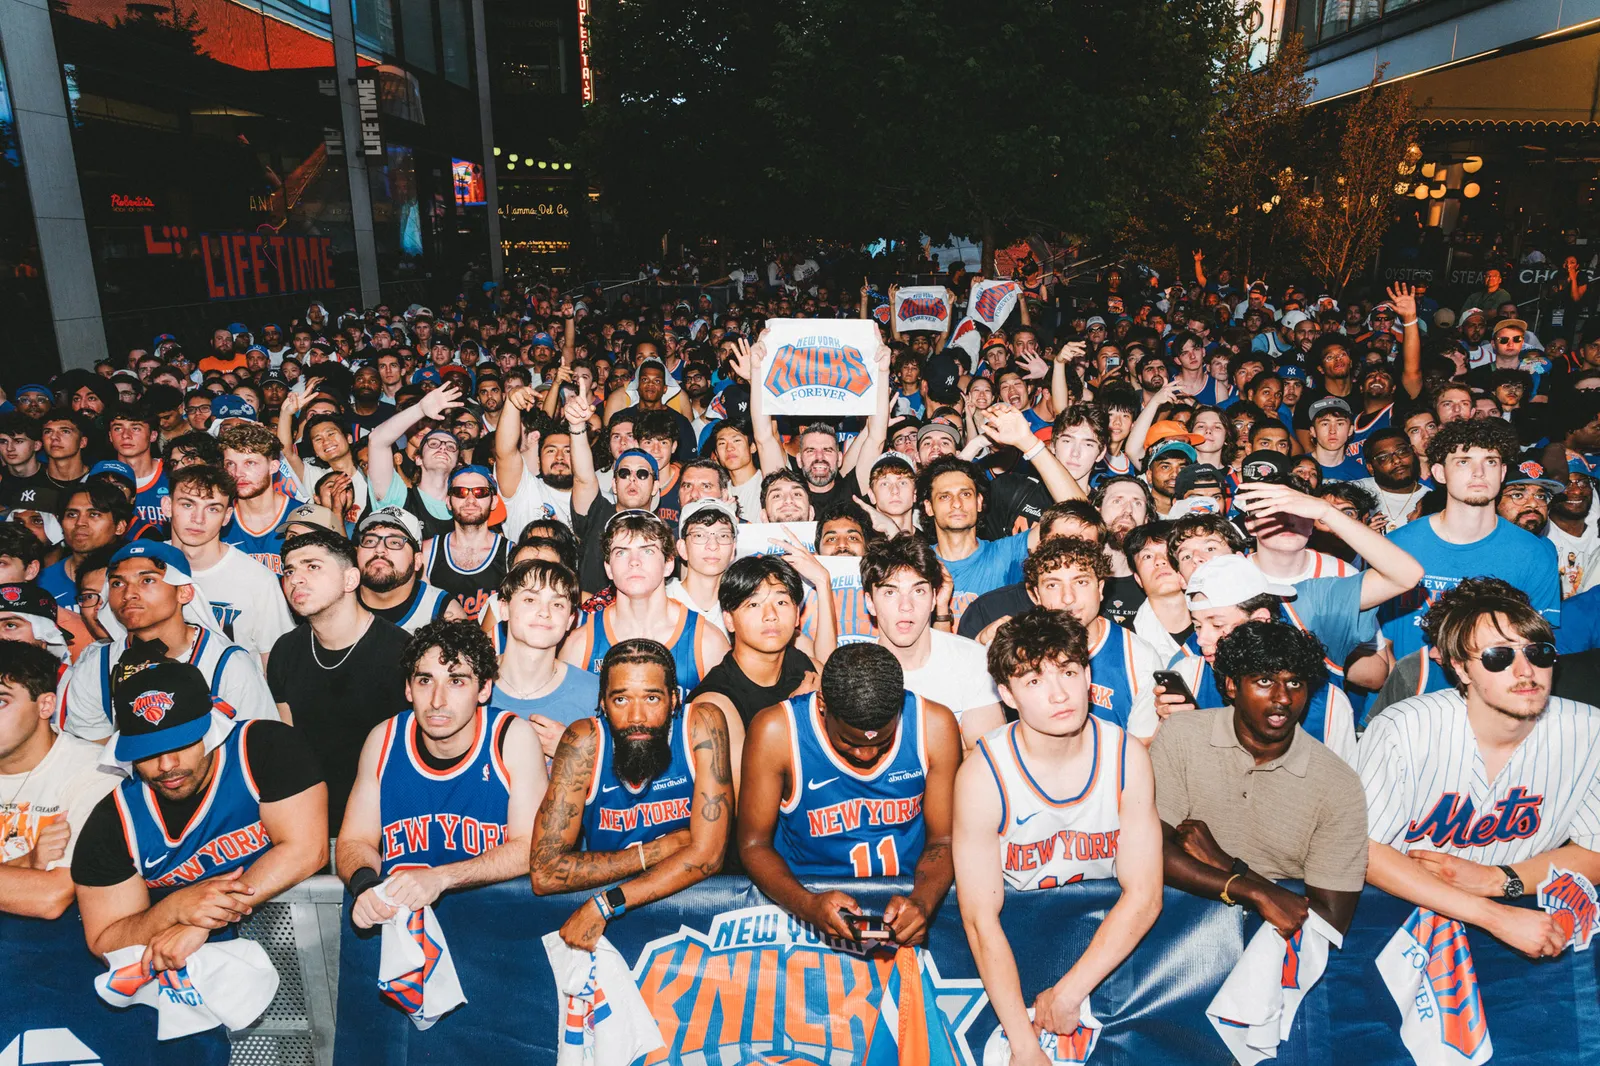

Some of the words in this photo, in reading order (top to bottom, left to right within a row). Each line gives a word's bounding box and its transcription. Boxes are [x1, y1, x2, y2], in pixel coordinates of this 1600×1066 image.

[111, 193, 155, 207] Roberta's
[201, 235, 269, 298] LIFE
[270, 236, 336, 293] TIME
[1452, 269, 1485, 284] STEA
[797, 336, 820, 349] NEW
[820, 336, 841, 348] YORK
[764, 344, 873, 398] KNICKS
[791, 386, 846, 401] FOREVER
[137, 505, 171, 522] YOR
[658, 507, 679, 522] ORK
[599, 805, 639, 832] NEW
[638, 797, 692, 828] YORK
[807, 799, 863, 837] NEW
[863, 794, 923, 825] YORK
[1404, 786, 1543, 848] Mets
[382, 814, 432, 862] EW
[849, 834, 900, 878] 11
[1005, 832, 1058, 872] NEW
[1058, 828, 1120, 861] YORK
[713, 913, 779, 948] NEW
[638, 942, 897, 1066] KNICK
